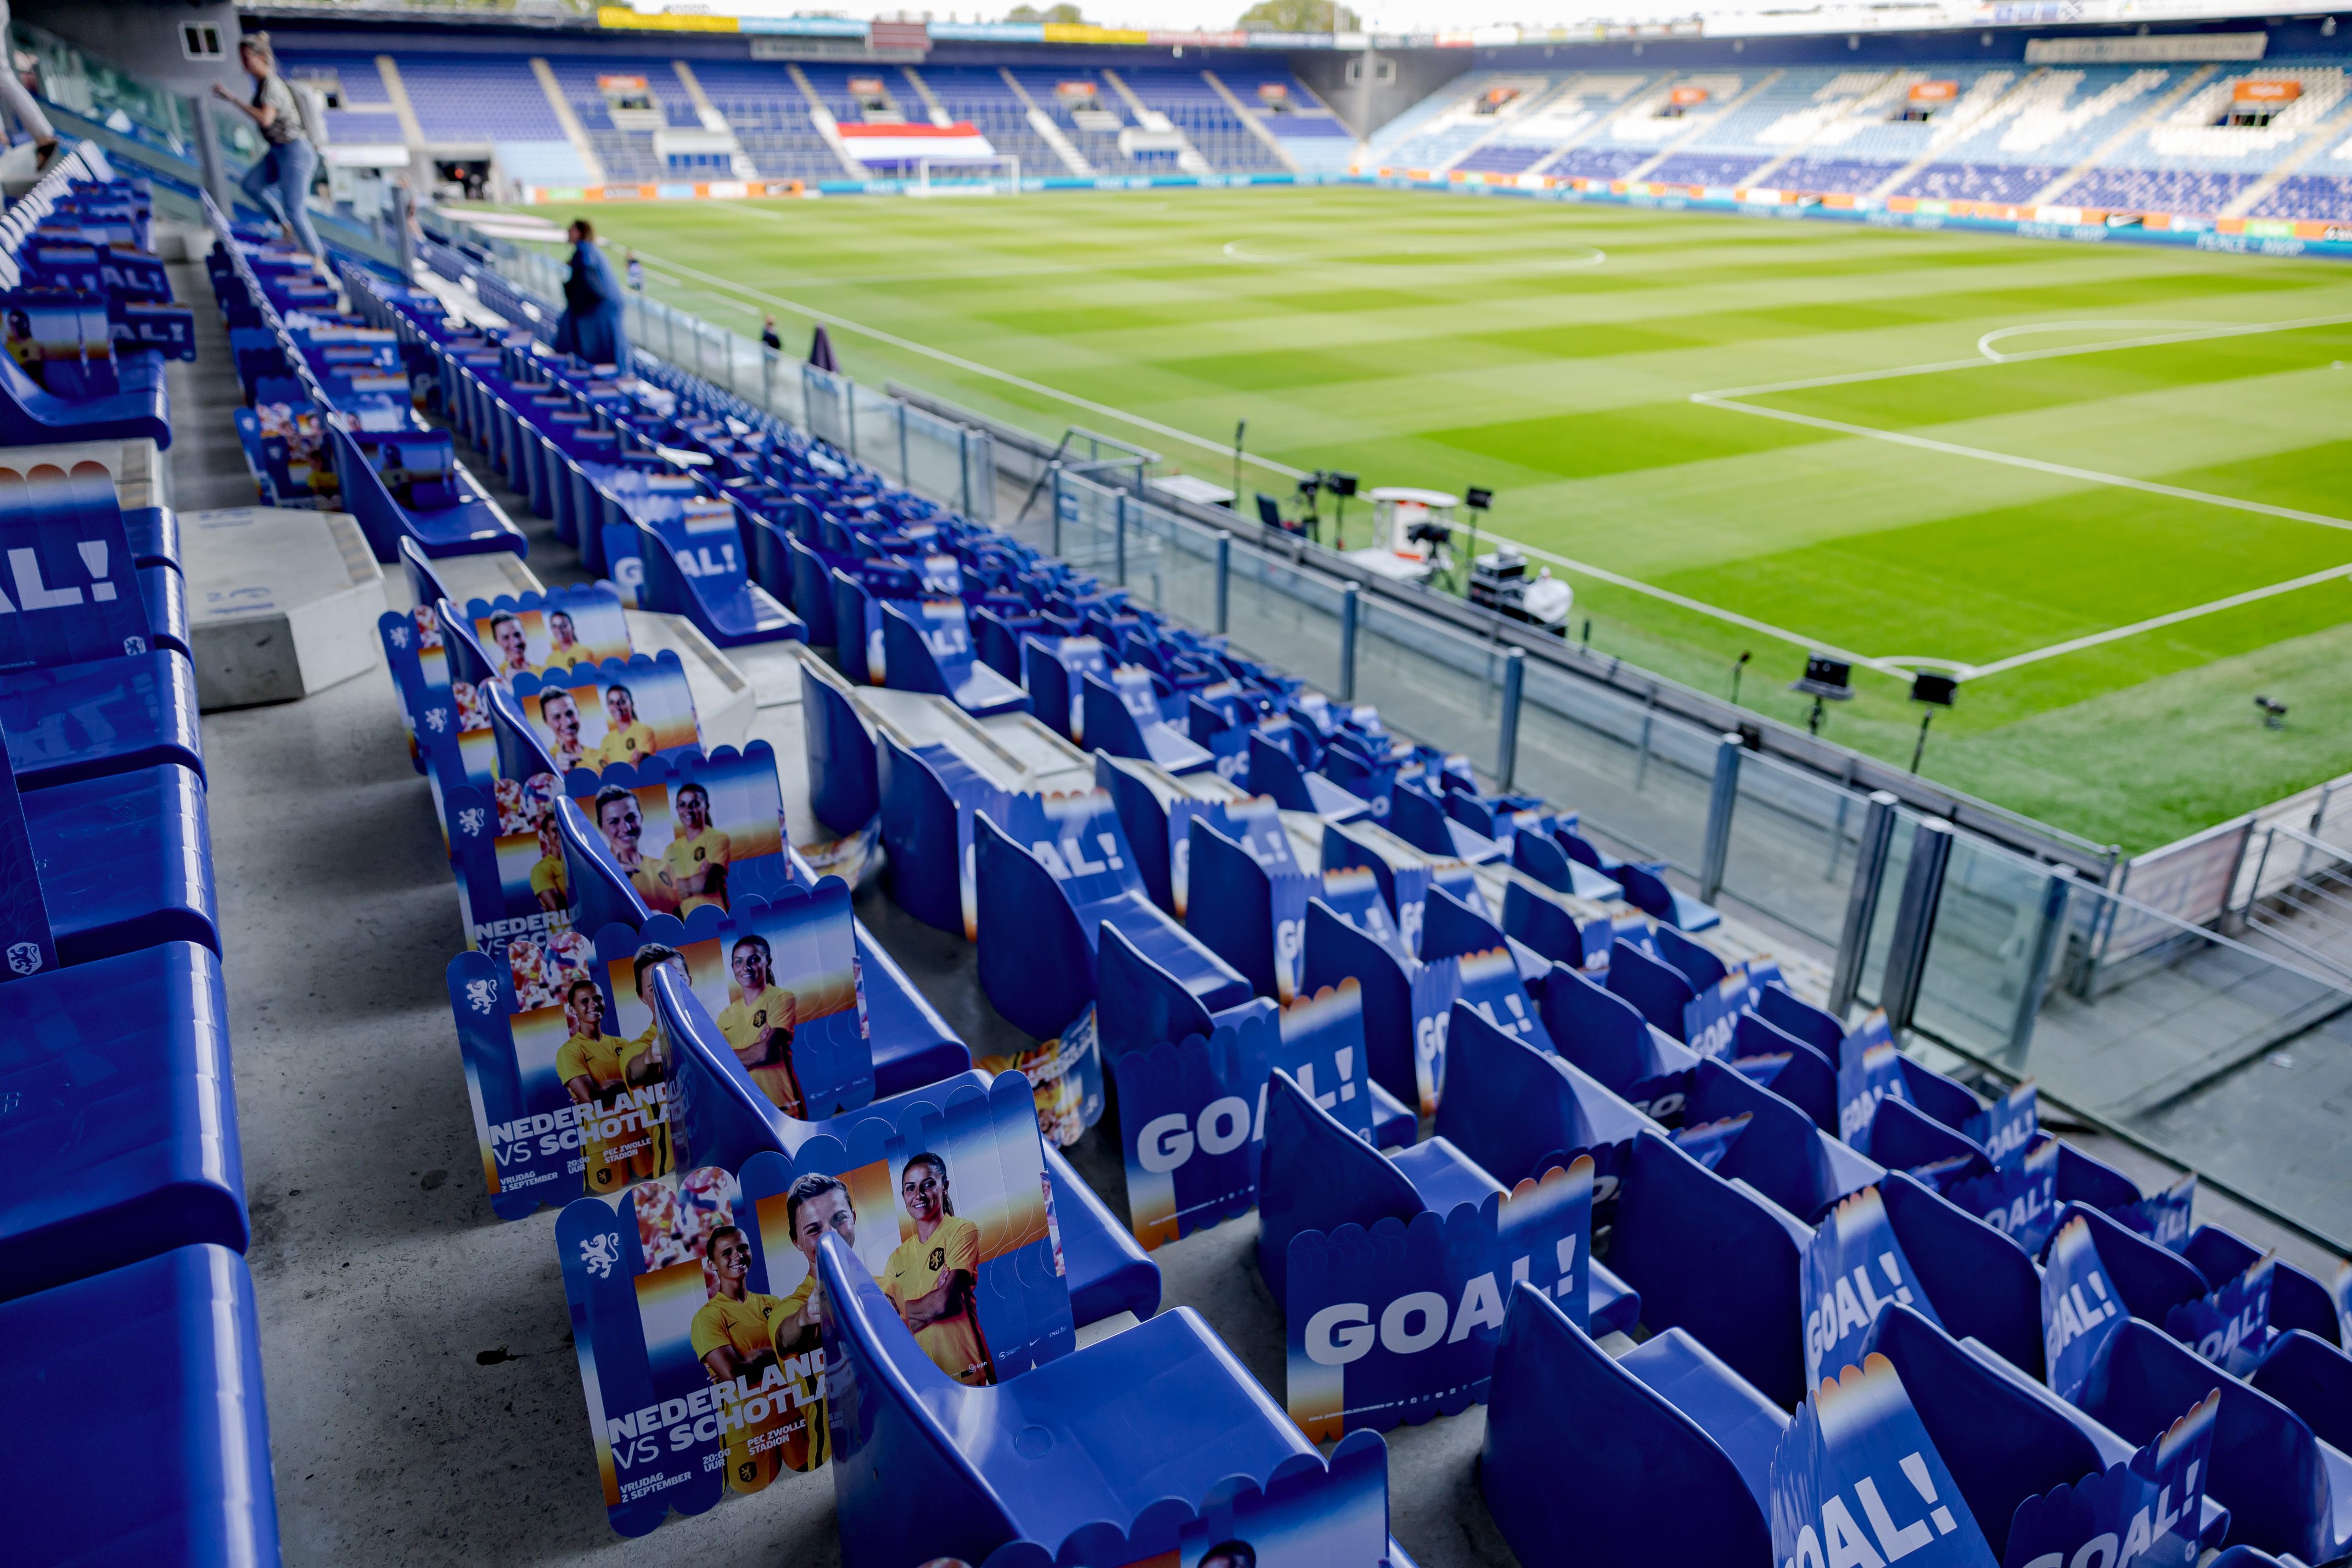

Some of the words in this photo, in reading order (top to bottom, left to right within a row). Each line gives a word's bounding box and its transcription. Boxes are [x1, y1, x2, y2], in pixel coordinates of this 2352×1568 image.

[1030, 832, 1124, 880] AL!
[474, 909, 570, 941] NEDERL
[1417, 993, 1533, 1061] GOL!
[1137, 1045, 1355, 1173] GOL!
[603, 1146, 619, 1157] PEC
[620, 1138, 652, 1152] ZWOLLE
[1984, 1109, 2034, 1163] OAL!
[493, 1142, 531, 1166] VS
[567, 1156, 590, 1168] 20:00
[604, 1149, 638, 1164] STADION
[499, 1171, 536, 1185] VRIJDAG
[509, 1172, 558, 1192] SEPTEMBER
[568, 1164, 586, 1174] UUR
[1984, 1177, 2052, 1234] OAL!
[1806, 1251, 1914, 1370] GOAL!
[1049, 1329, 1060, 1338] ING
[2182, 1292, 2266, 1363] OAL!
[607, 1347, 825, 1444] NEDERLAND
[747, 1434, 765, 1447] PEC
[768, 1419, 806, 1441] ZWOLLE
[749, 1434, 790, 1456] STADION
[611, 1435, 659, 1470] VS
[702, 1447, 731, 1464] 20:00
[704, 1458, 726, 1473] UUR
[620, 1472, 663, 1494] VRIJDAG
[621, 1494, 628, 1503] 2
[631, 1471, 692, 1502] SEPTEMBER
[1784, 1451, 1957, 1568] OAL!
